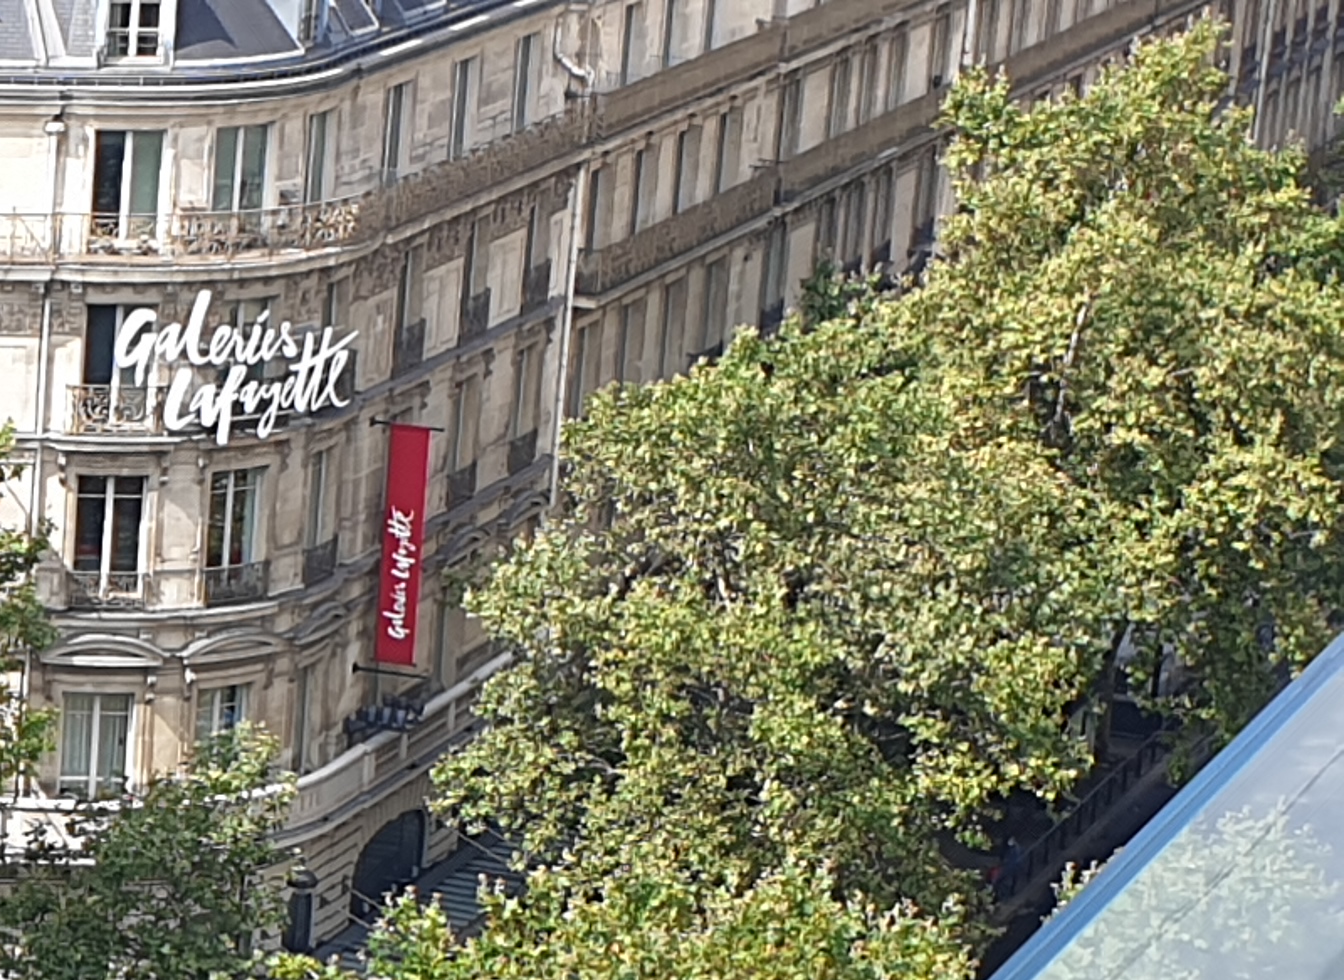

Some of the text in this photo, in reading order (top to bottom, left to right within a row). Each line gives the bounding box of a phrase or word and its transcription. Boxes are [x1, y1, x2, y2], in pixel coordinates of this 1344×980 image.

[115, 290, 298, 387] Galeries
[164, 326, 359, 446] Lafayette
[382, 505, 416, 639] Galeries Lafayette
